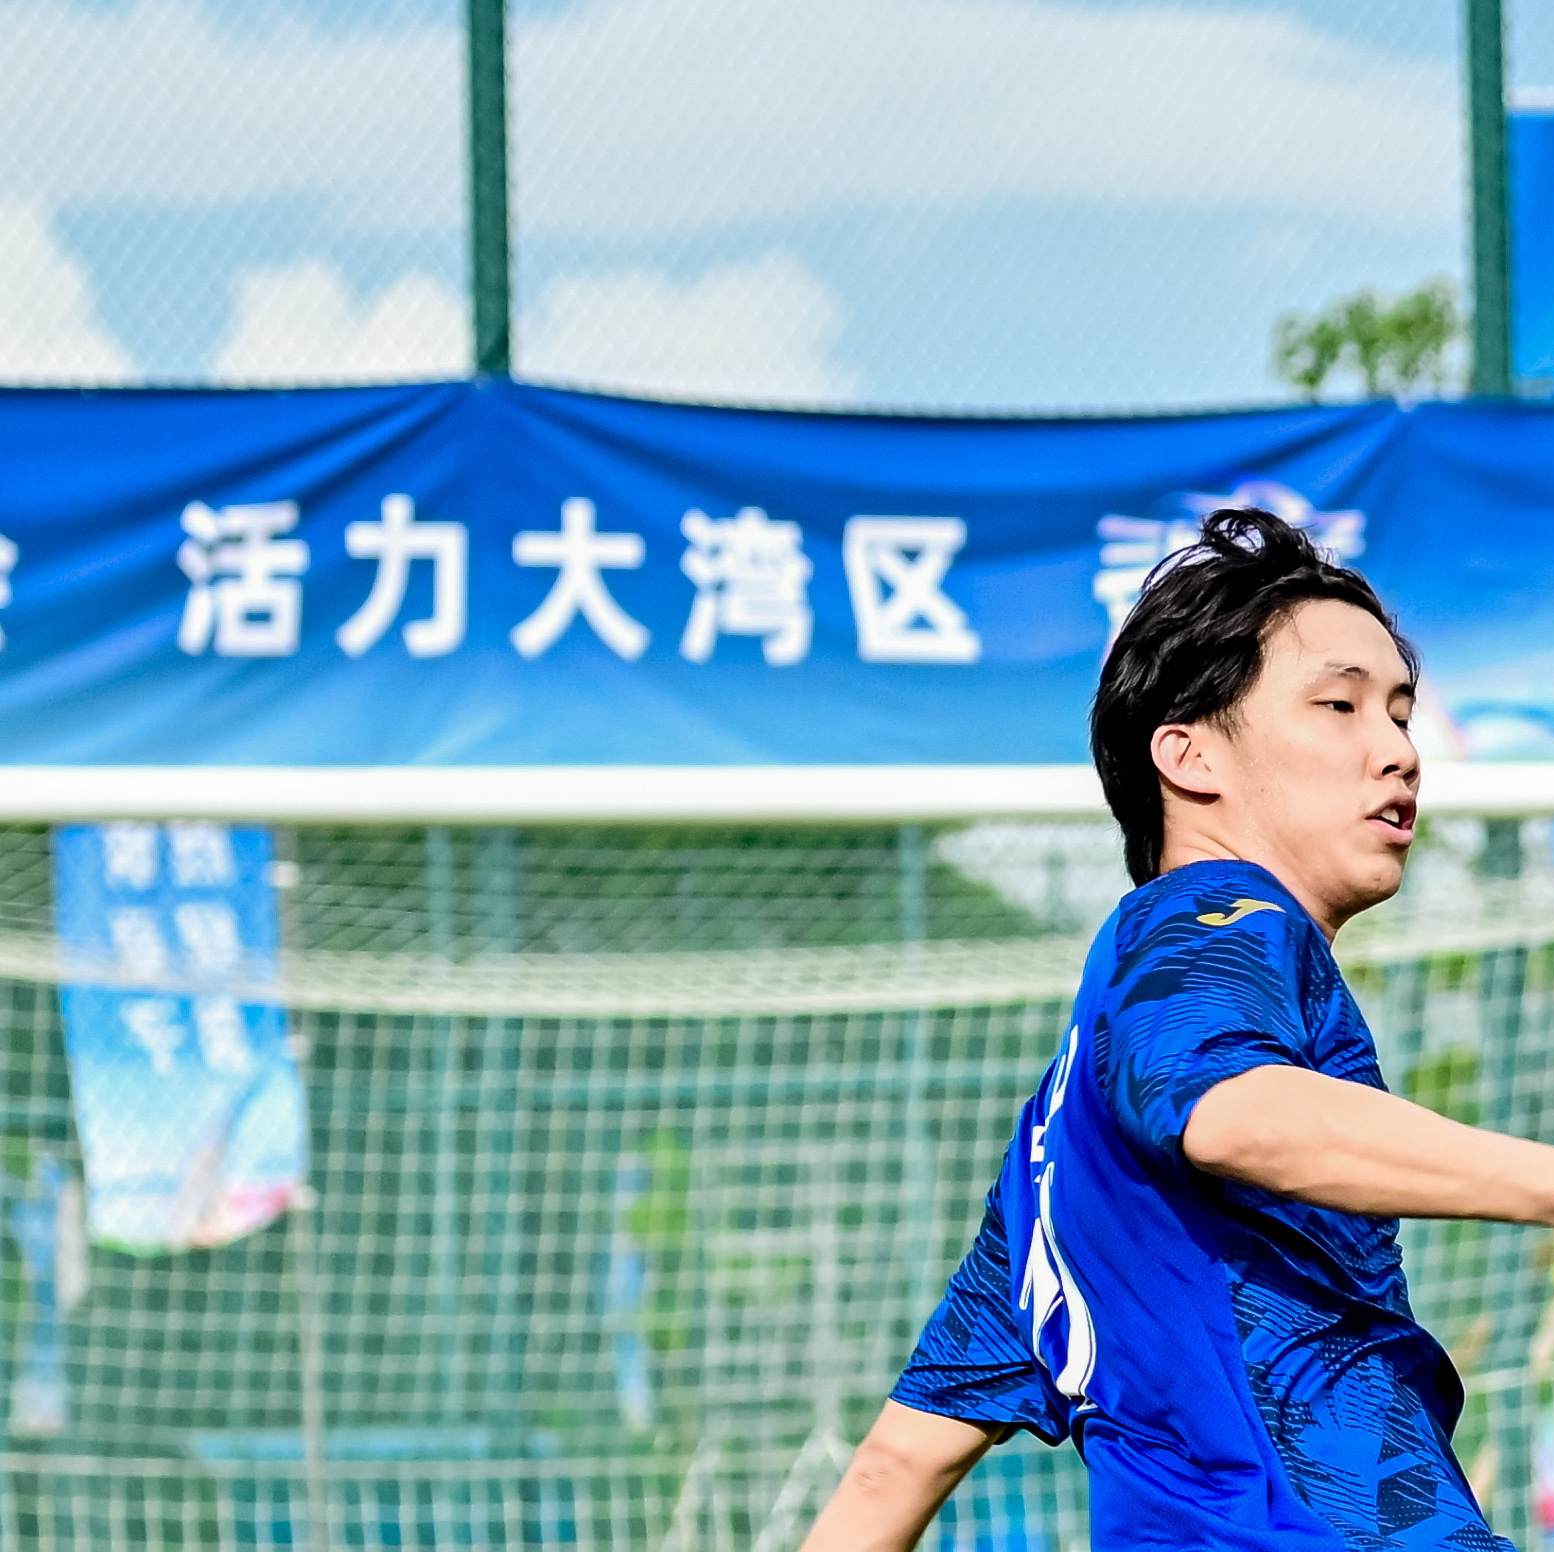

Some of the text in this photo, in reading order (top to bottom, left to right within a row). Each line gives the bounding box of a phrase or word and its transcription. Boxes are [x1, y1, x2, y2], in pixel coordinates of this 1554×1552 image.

[176, 493, 982, 666] 活力大湾区
